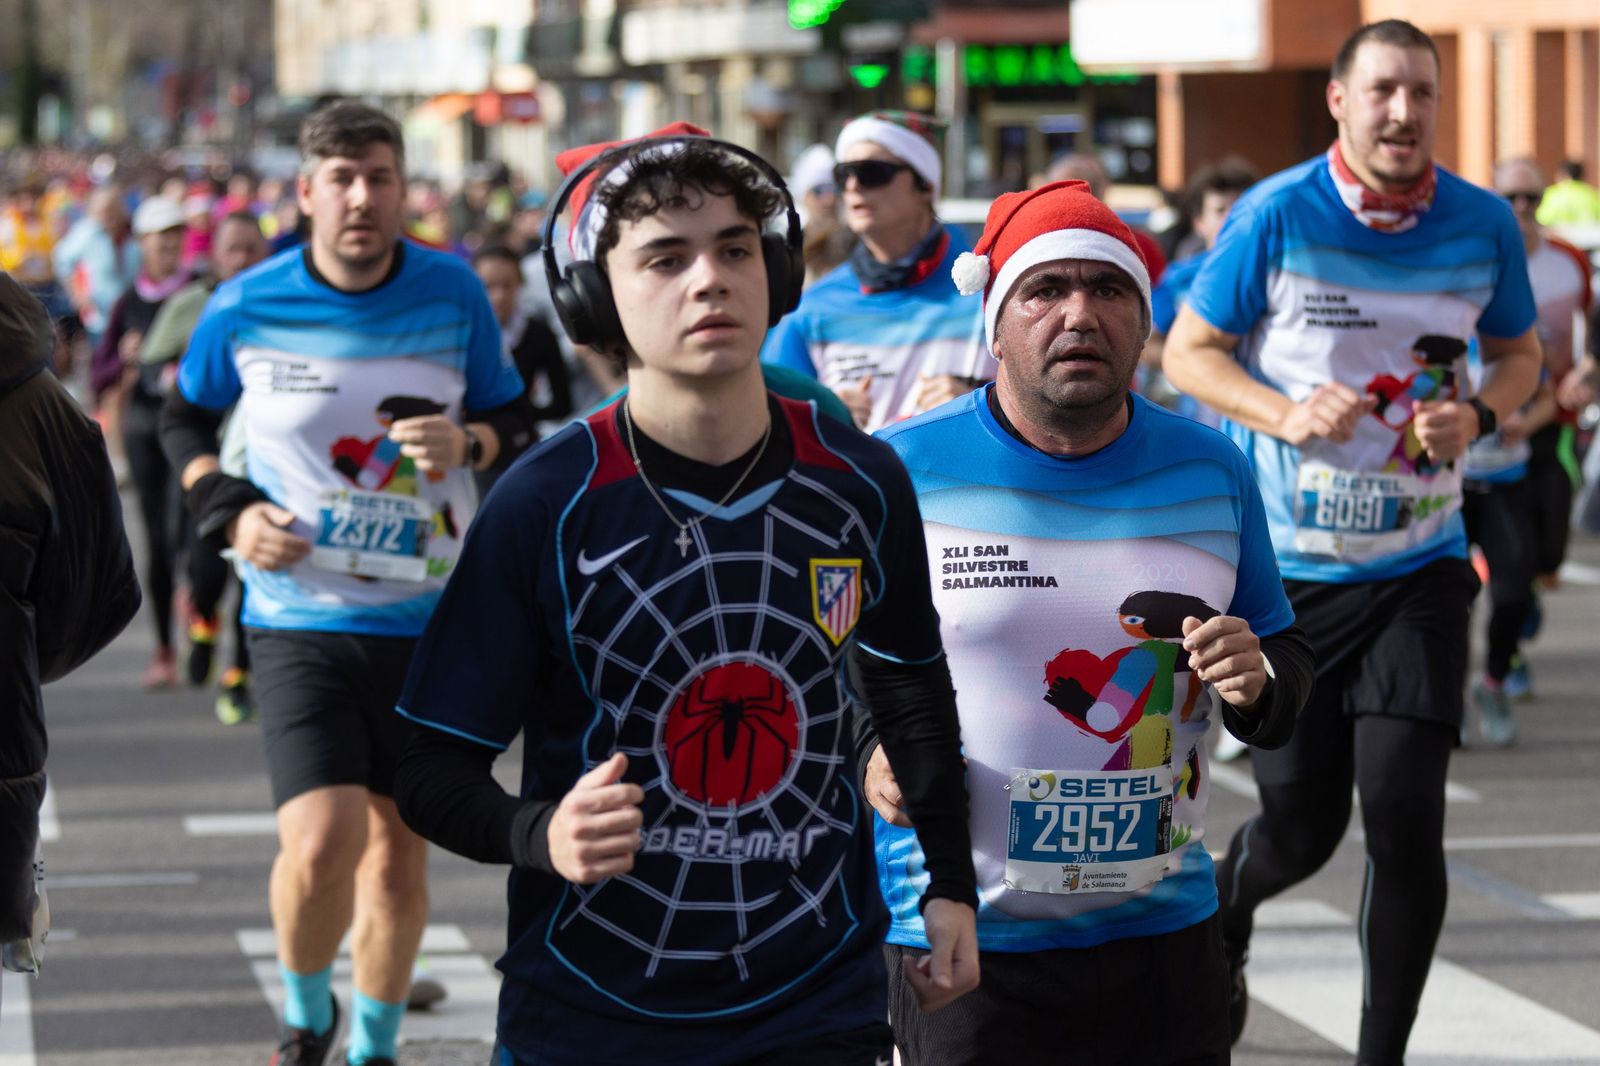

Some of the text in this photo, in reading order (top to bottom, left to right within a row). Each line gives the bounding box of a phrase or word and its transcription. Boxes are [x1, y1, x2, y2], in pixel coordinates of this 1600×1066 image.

[1333, 474, 1404, 493] SETEL
[351, 496, 418, 514] SETEL
[1315, 493, 1385, 531] 6091
[328, 507, 404, 550] 2372
[942, 545, 1009, 559] XLI SAN
[942, 560, 1028, 574] SILVESTRE
[1131, 562, 1188, 582] 2020
[942, 576, 1059, 590] SALMANTINA
[1060, 775, 1162, 798] SETEL
[1032, 803, 1142, 853] 2952
[1073, 853, 1101, 863] JAVI
[1083, 872, 1128, 881] Ayuntamiento
[1091, 881, 1126, 889] Salamanca
